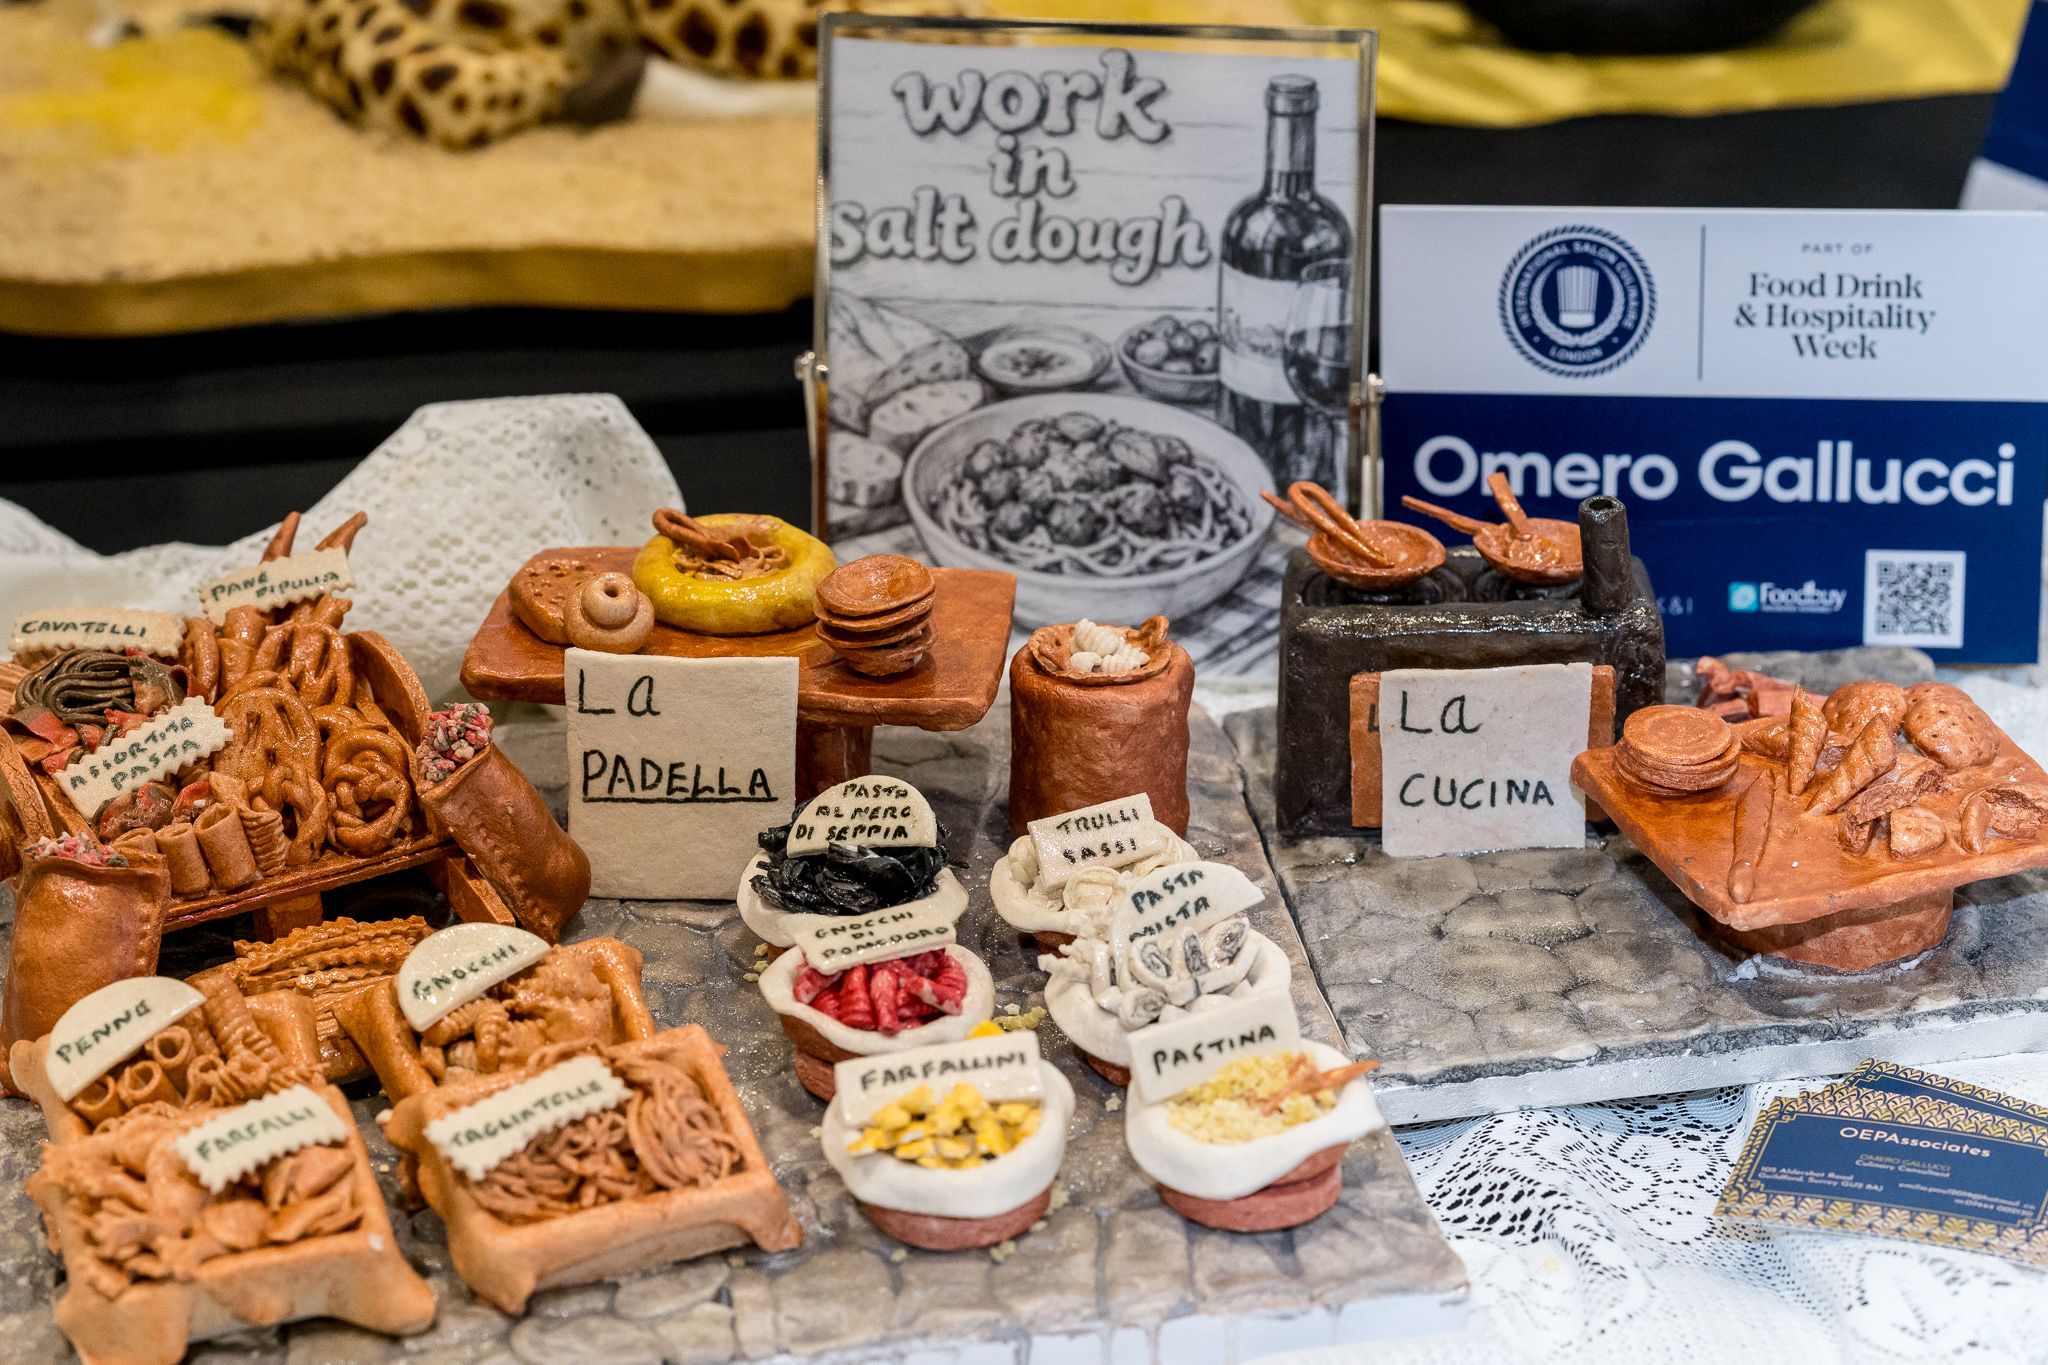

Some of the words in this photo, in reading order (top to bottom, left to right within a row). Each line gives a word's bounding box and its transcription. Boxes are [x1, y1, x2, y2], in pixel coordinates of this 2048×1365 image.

[891, 48, 1173, 145] work
[988, 133, 1076, 198] in
[989, 195, 1212, 286] dough
[1572, 240, 1619, 264] SALON
[1802, 243, 1843, 253] PART
[1852, 243, 1874, 255] OF
[1750, 272, 1826, 298] Food
[1837, 273, 1922, 299] Drink
[1735, 303, 1756, 328] &
[1766, 303, 1936, 335] Hospitality
[1549, 345, 1603, 363] LONDON
[1792, 333, 1878, 360] Week
[1413, 434, 1679, 502] Omero
[1698, 439, 2016, 506] Gallucci
[211, 571, 268, 601] PANE
[1760, 580, 1848, 613] Foodbuy
[21, 620, 147, 638] CAVATELLI
[111, 739, 201, 791] PASTA
[582, 749, 778, 803] PADELLA
[1399, 773, 1555, 810] CUCINA
[851, 805, 911, 821] NERO
[1056, 808, 1140, 835] TRULLI
[795, 823, 815, 840] DI
[825, 823, 909, 841] SEPPIA
[1062, 838, 1137, 865] SASSI
[1130, 869, 1206, 914] PASTA
[815, 911, 914, 939] GNOCCHI
[851, 931, 875, 940] DI
[412, 944, 519, 1001] GNOCCHI
[56, 999, 151, 1064] PENNE
[1152, 1024, 1276, 1076] PASTINA
[860, 1051, 1027, 1091] FARFALLINI
[452, 1079, 603, 1147] TAGLIATELLE
[197, 1107, 316, 1163] FARFALLI
[1839, 1126, 1992, 1158] OEPAssociates
